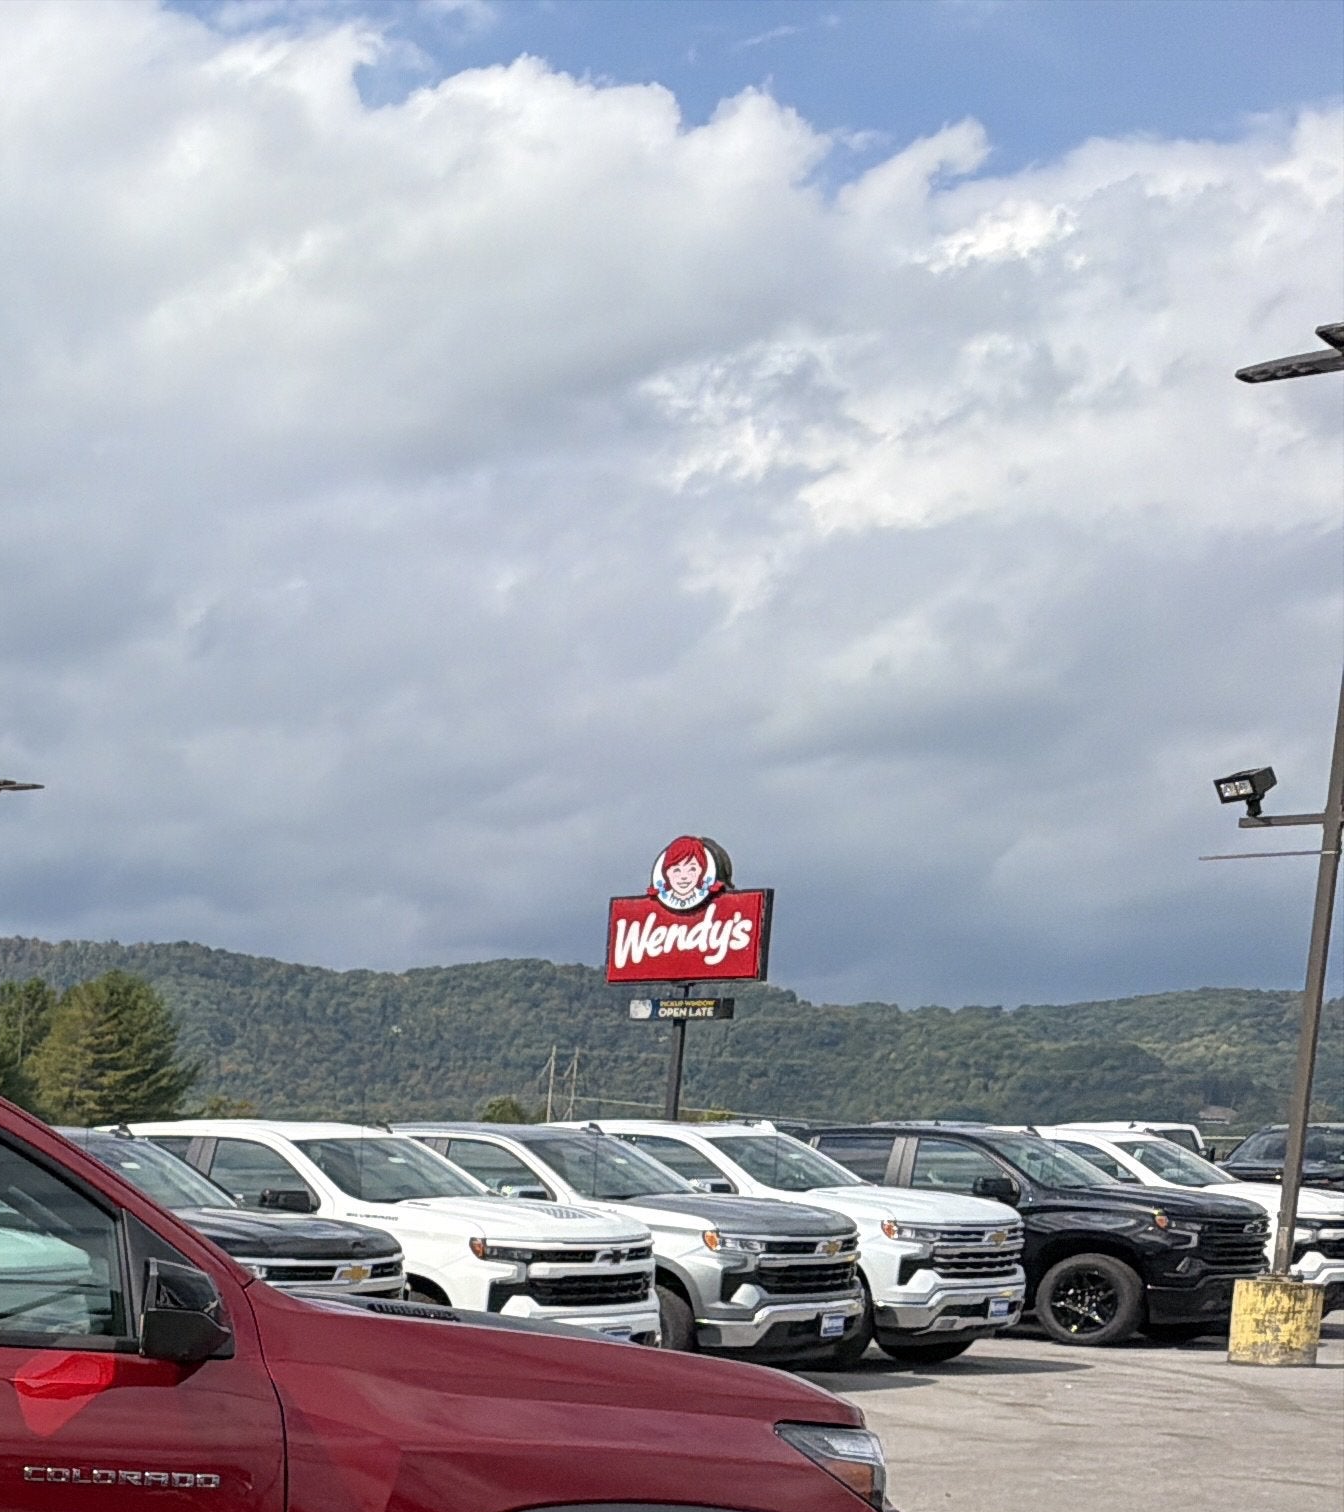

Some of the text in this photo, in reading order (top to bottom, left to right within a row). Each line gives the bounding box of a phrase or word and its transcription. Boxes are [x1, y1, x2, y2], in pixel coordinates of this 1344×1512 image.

[614, 903, 753, 969] Wendy's
[658, 1006, 714, 1018] OPEN LATE
[23, 1466, 221, 1488] COLORADO
